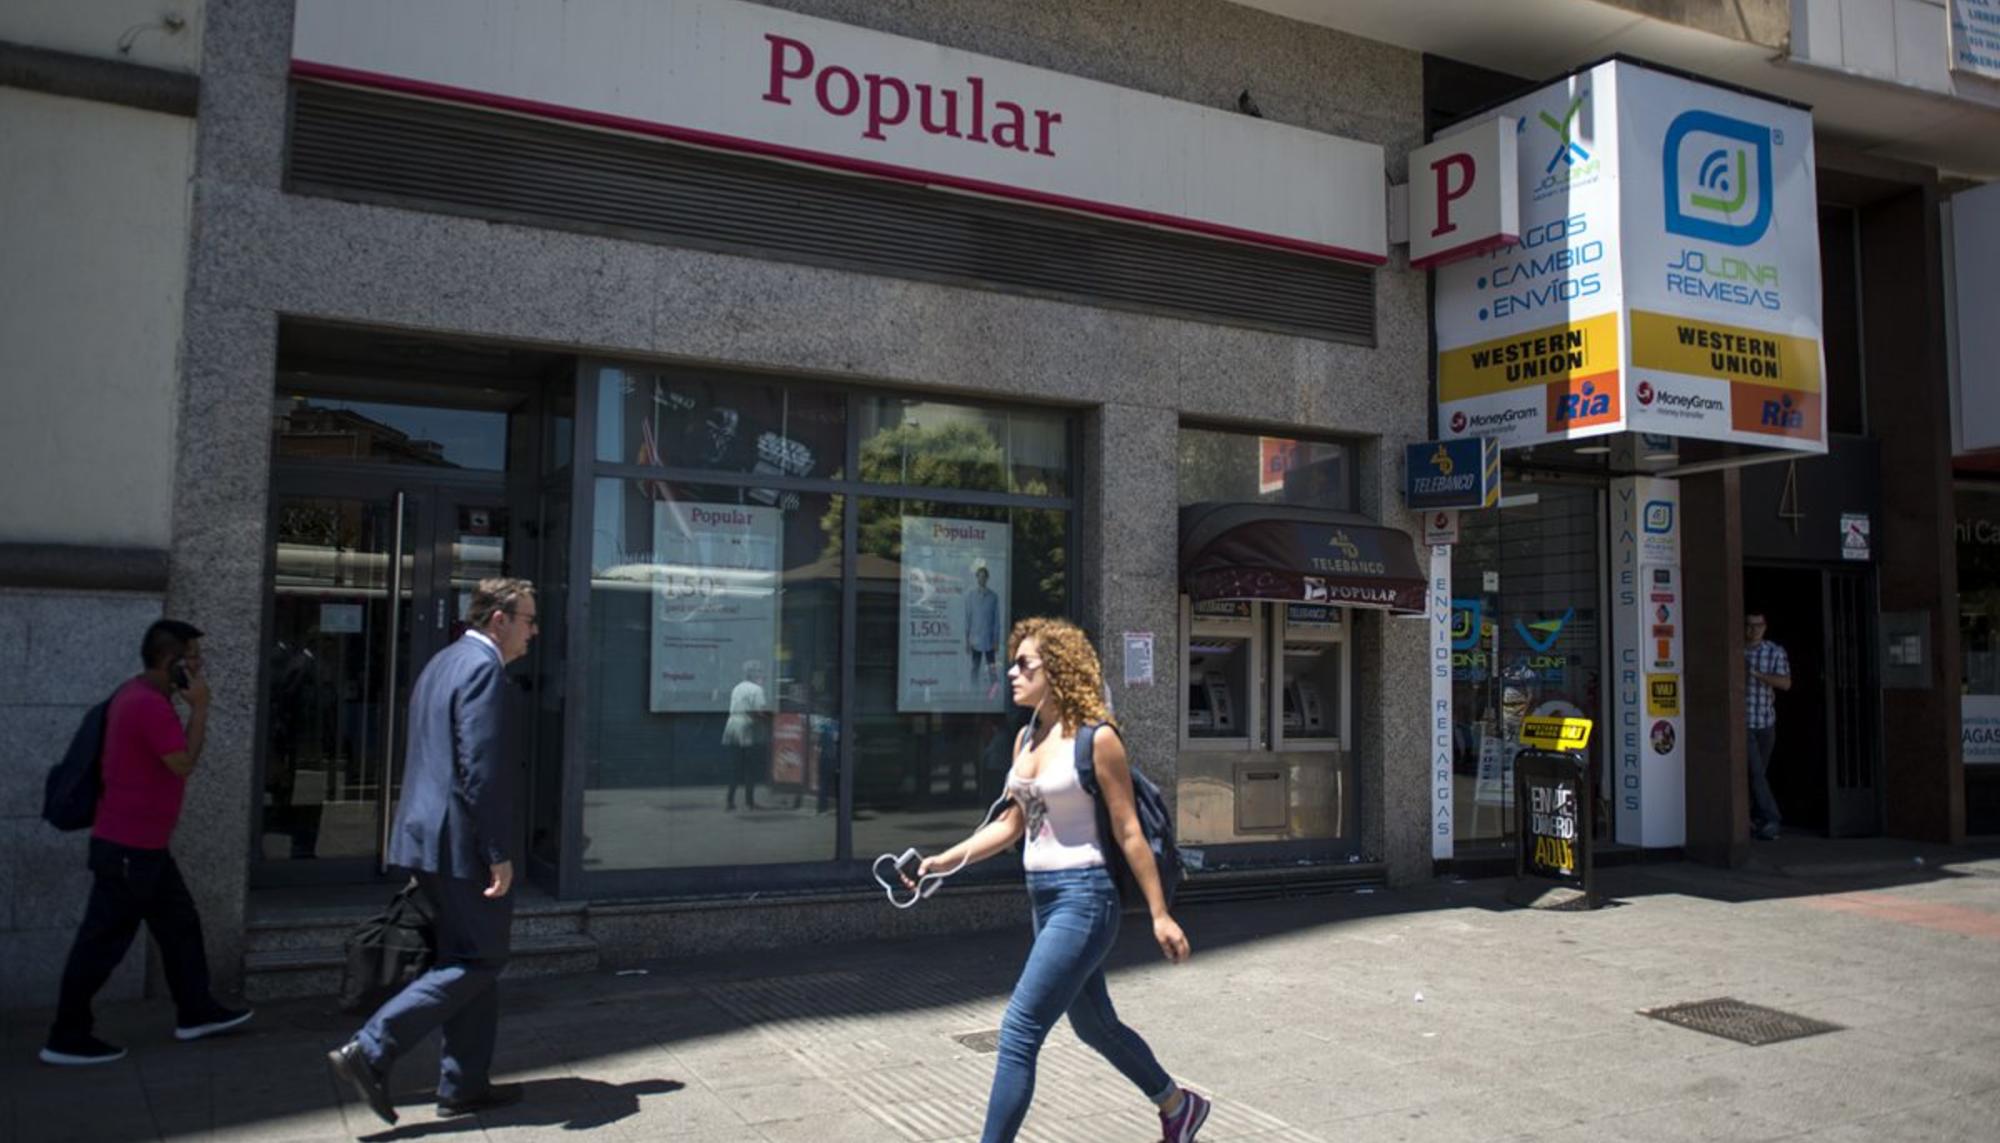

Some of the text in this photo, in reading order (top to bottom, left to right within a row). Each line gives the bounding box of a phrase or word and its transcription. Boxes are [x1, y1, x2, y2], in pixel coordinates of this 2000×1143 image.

[762, 33, 1062, 157] Popular
[1431, 153, 1476, 238] P
[1492, 213, 1588, 260] AGOS
[1492, 240, 1604, 289] CAMBIO
[1667, 249, 1779, 286] JOLDINA
[1494, 273, 1601, 318] ENVÍOS
[1666, 272, 1781, 311] REMESAS
[1471, 329, 1582, 370] WESTERN
[1677, 325, 1776, 357] WESTERN
[1506, 351, 1583, 383] UNION
[1711, 352, 1778, 379] UNION
[1556, 380, 1610, 422] Ria
[1761, 393, 1804, 429] Ria
[1413, 473, 1475, 494] TELEBANCO
[691, 507, 753, 527] Popular
[933, 523, 986, 543] Popular
[1311, 557, 1386, 574] TELEBANCO
[1330, 586, 1397, 602] POPULAR
[1435, 577, 1449, 678] ENVIOS
[1622, 648, 1640, 811] CRUCEROS
[1435, 700, 1450, 836] RECARGAS
